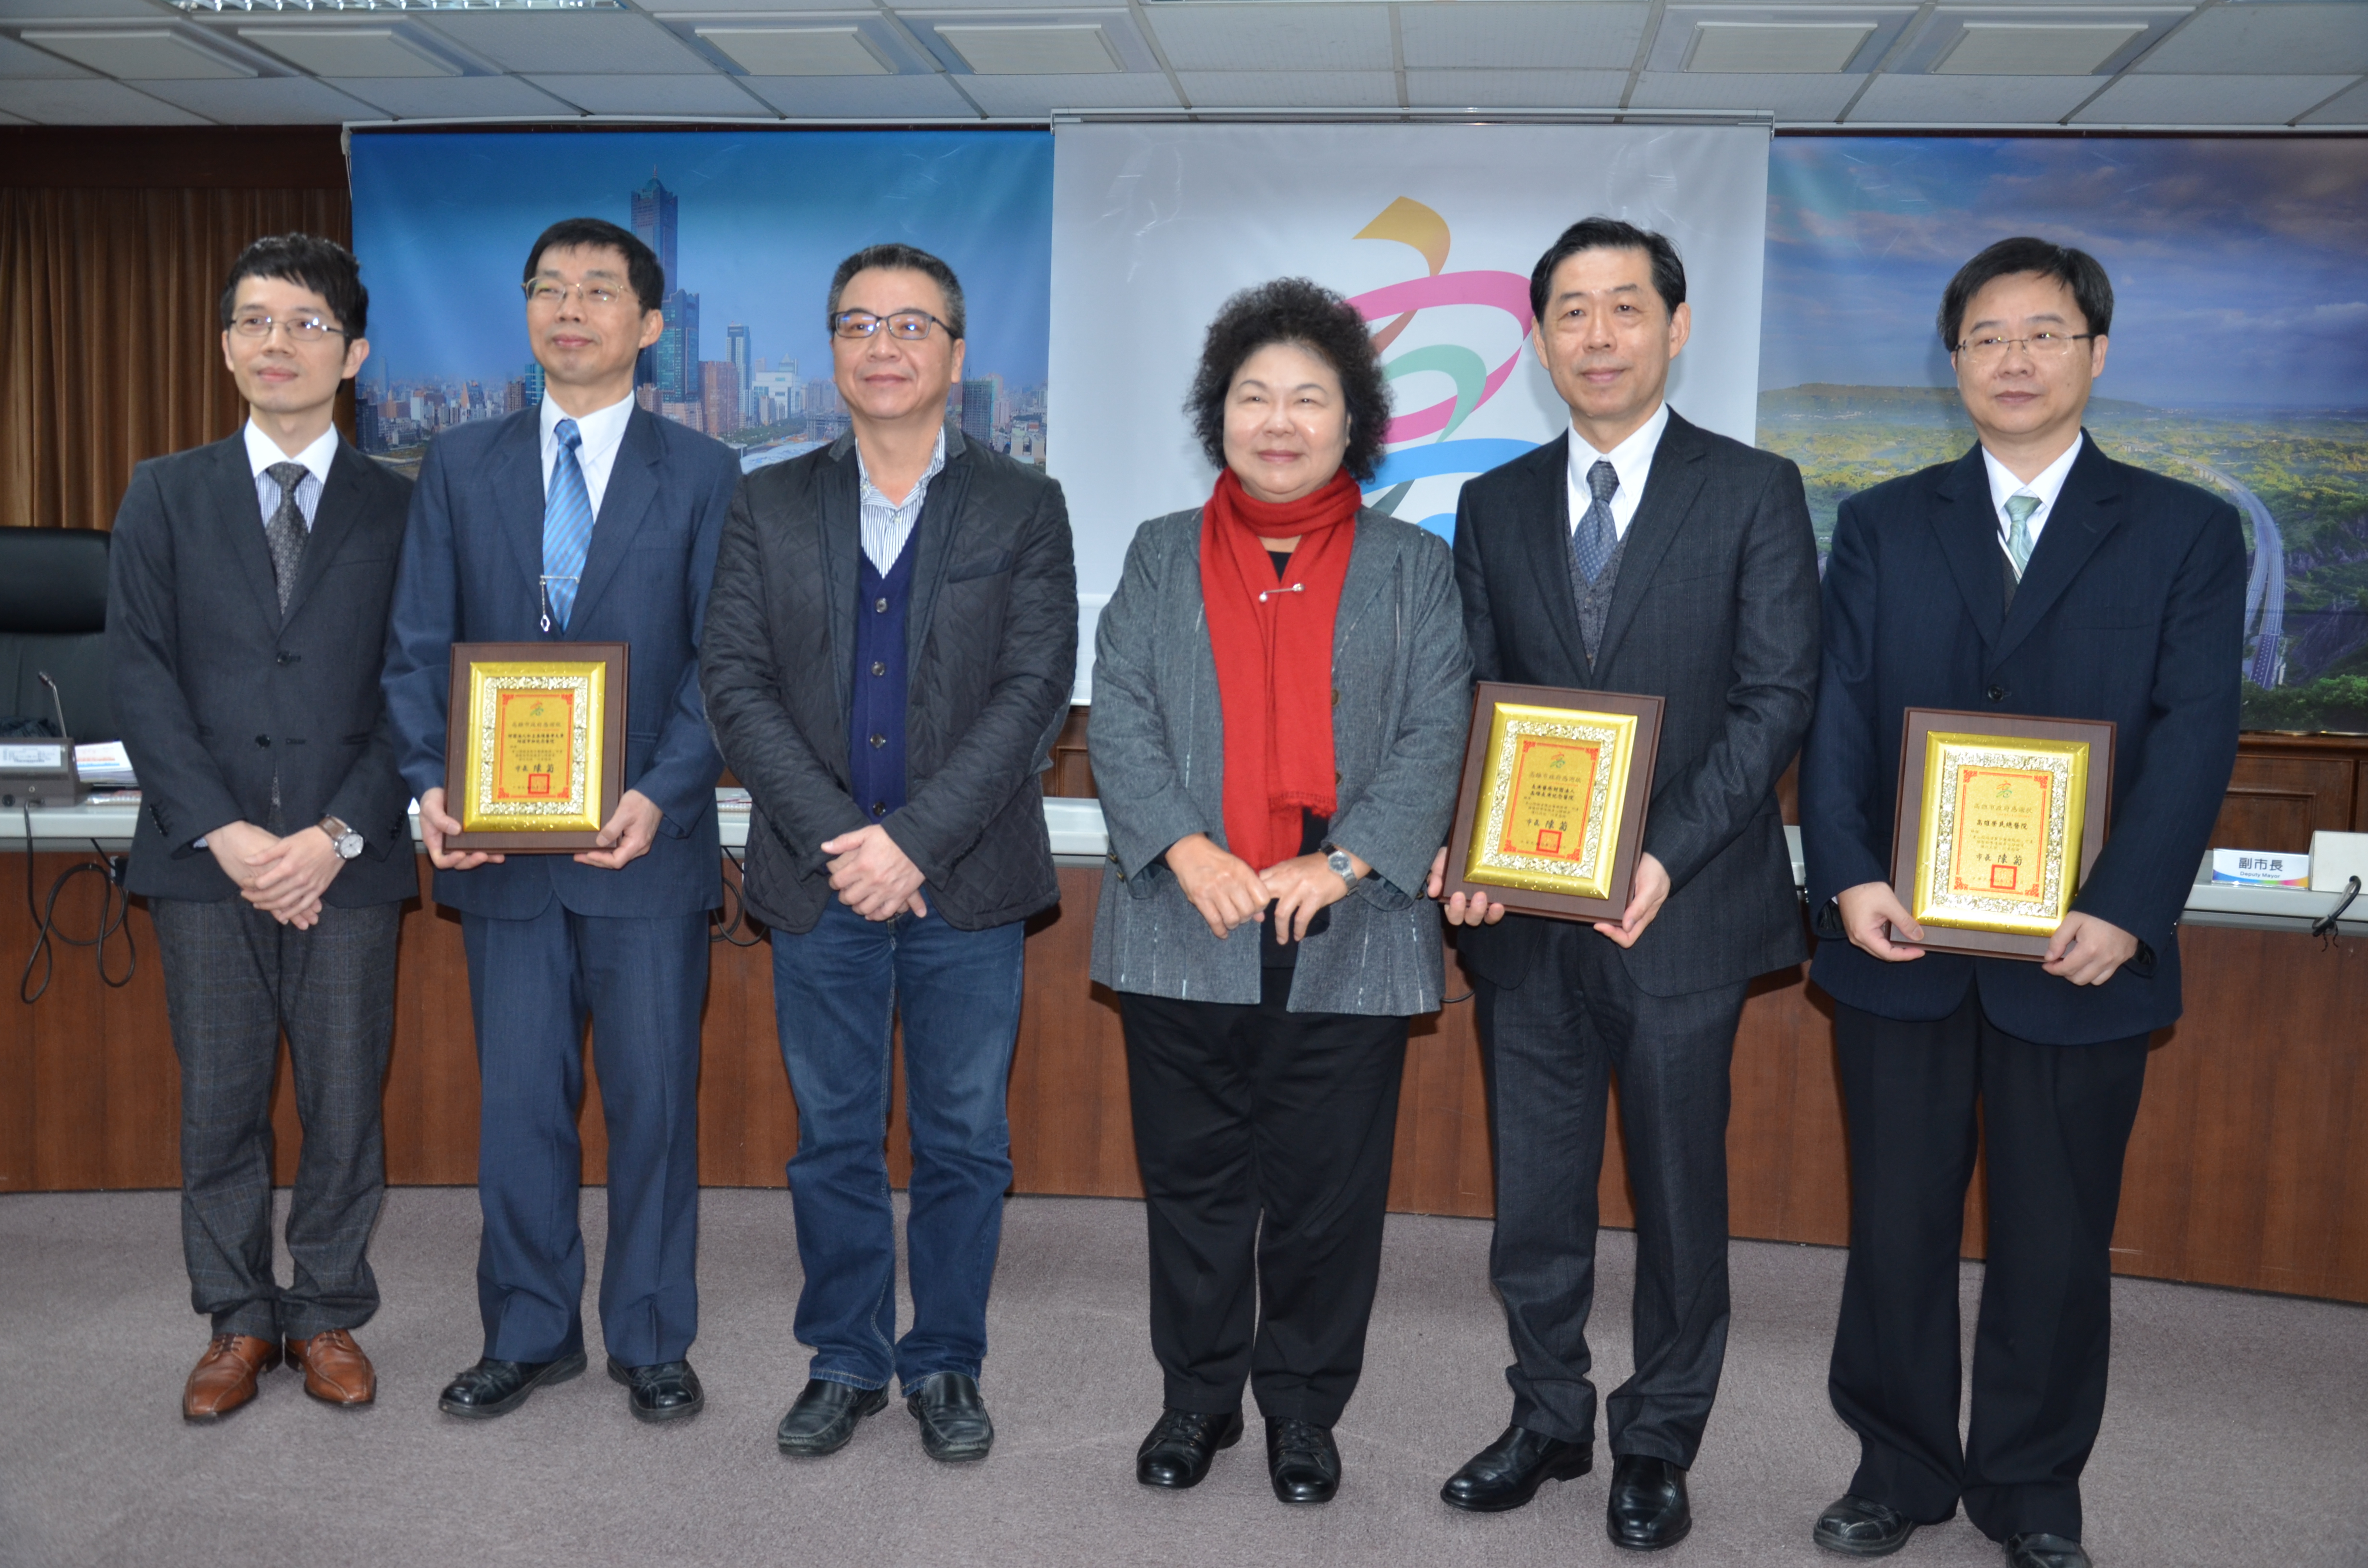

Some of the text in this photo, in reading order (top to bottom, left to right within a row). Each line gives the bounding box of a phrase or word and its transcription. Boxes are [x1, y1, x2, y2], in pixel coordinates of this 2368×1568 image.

[1973, 803, 2033, 813] 高雄市政府感謝狀
[1976, 819, 2028, 830] 高雄榮民總醫院
[1975, 853, 1992, 861] 市長
[2238, 857, 2283, 872] 副市長
